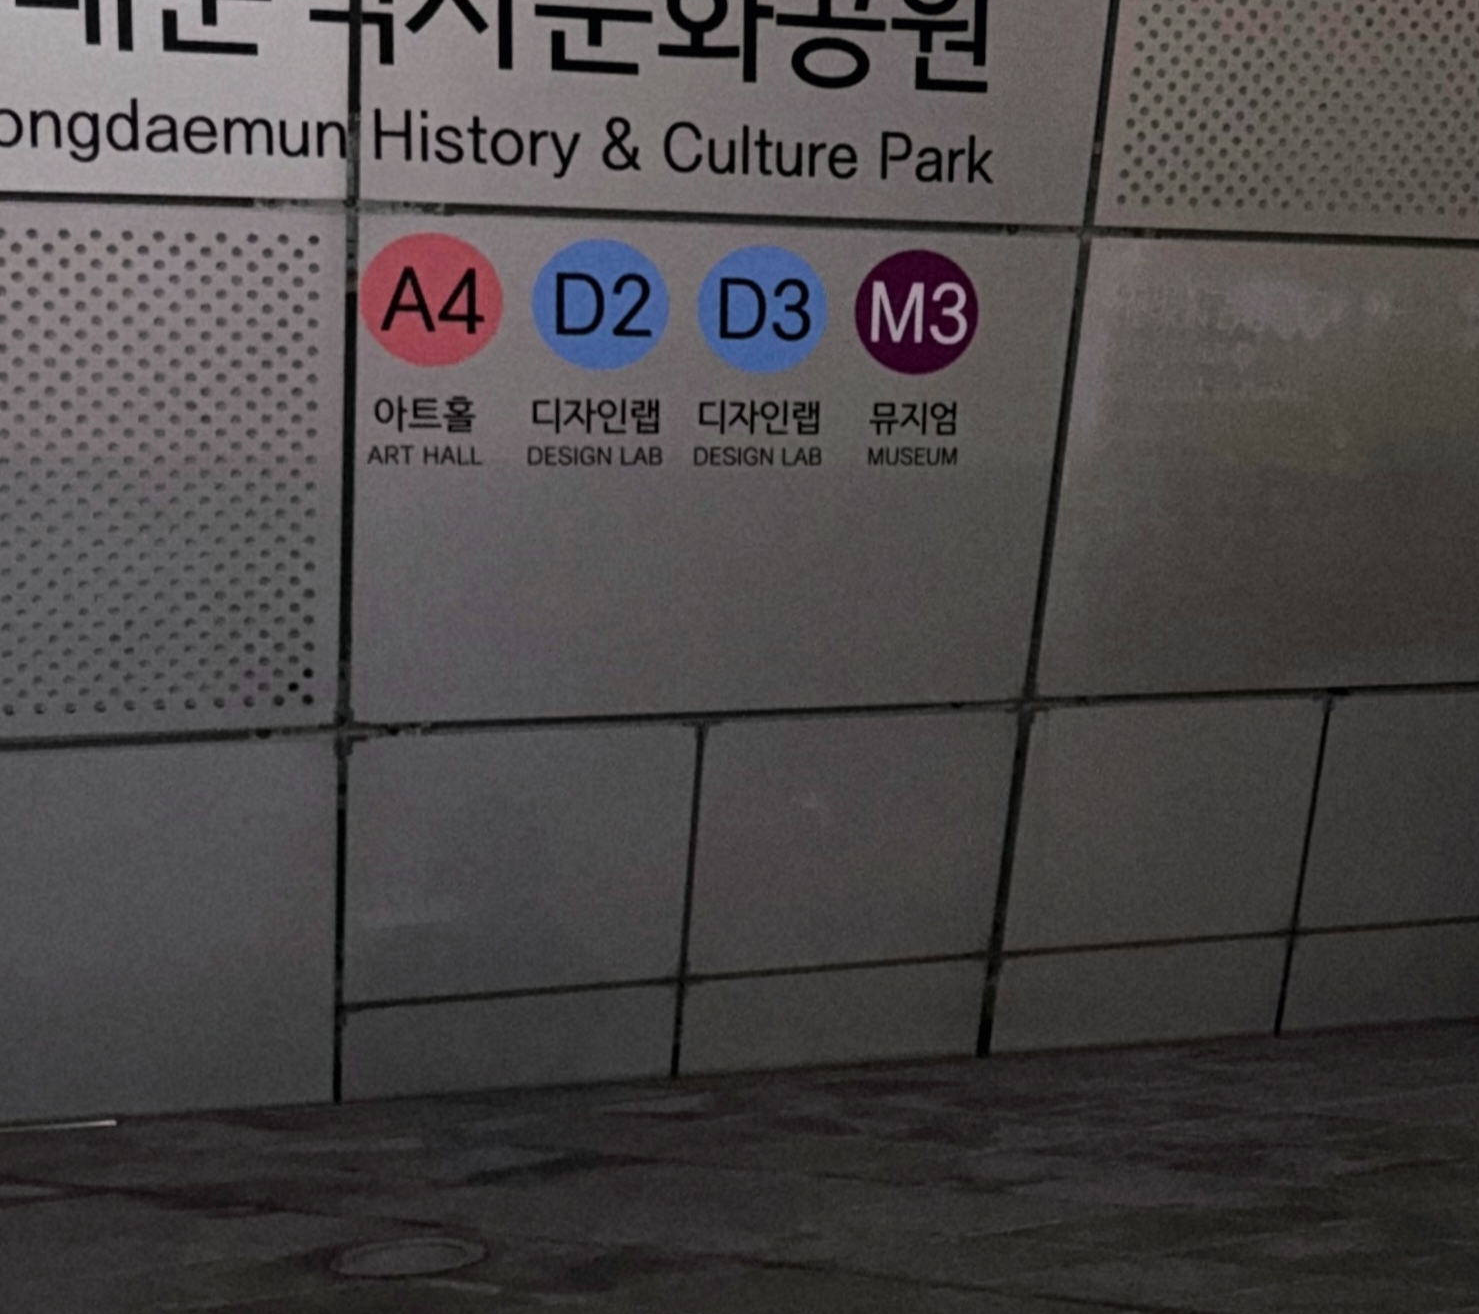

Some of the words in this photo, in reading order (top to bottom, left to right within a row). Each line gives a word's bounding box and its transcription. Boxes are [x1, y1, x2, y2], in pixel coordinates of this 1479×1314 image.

[0, 98, 347, 163] ongdaemun
[373, 108, 581, 179] History
[601, 116, 641, 171] &
[663, 121, 858, 180] Culture
[880, 130, 994, 185] Park
[380, 266, 485, 335] A4
[555, 271, 652, 338] D2
[719, 277, 811, 342] D3
[869, 281, 969, 346] M3
[374, 395, 476, 434] 아트홀
[532, 397, 660, 435] 디자인랩
[698, 399, 821, 436] 디자인랩
[869, 401, 958, 436] 뮤지엄
[367, 445, 414, 466] ART
[423, 445, 483, 466] HALL
[527, 446, 612, 467] DESIGN
[620, 446, 663, 467] LAB
[693, 446, 774, 467] DESIGN
[781, 446, 822, 467] LAB
[867, 447, 958, 466] MUSEUM
